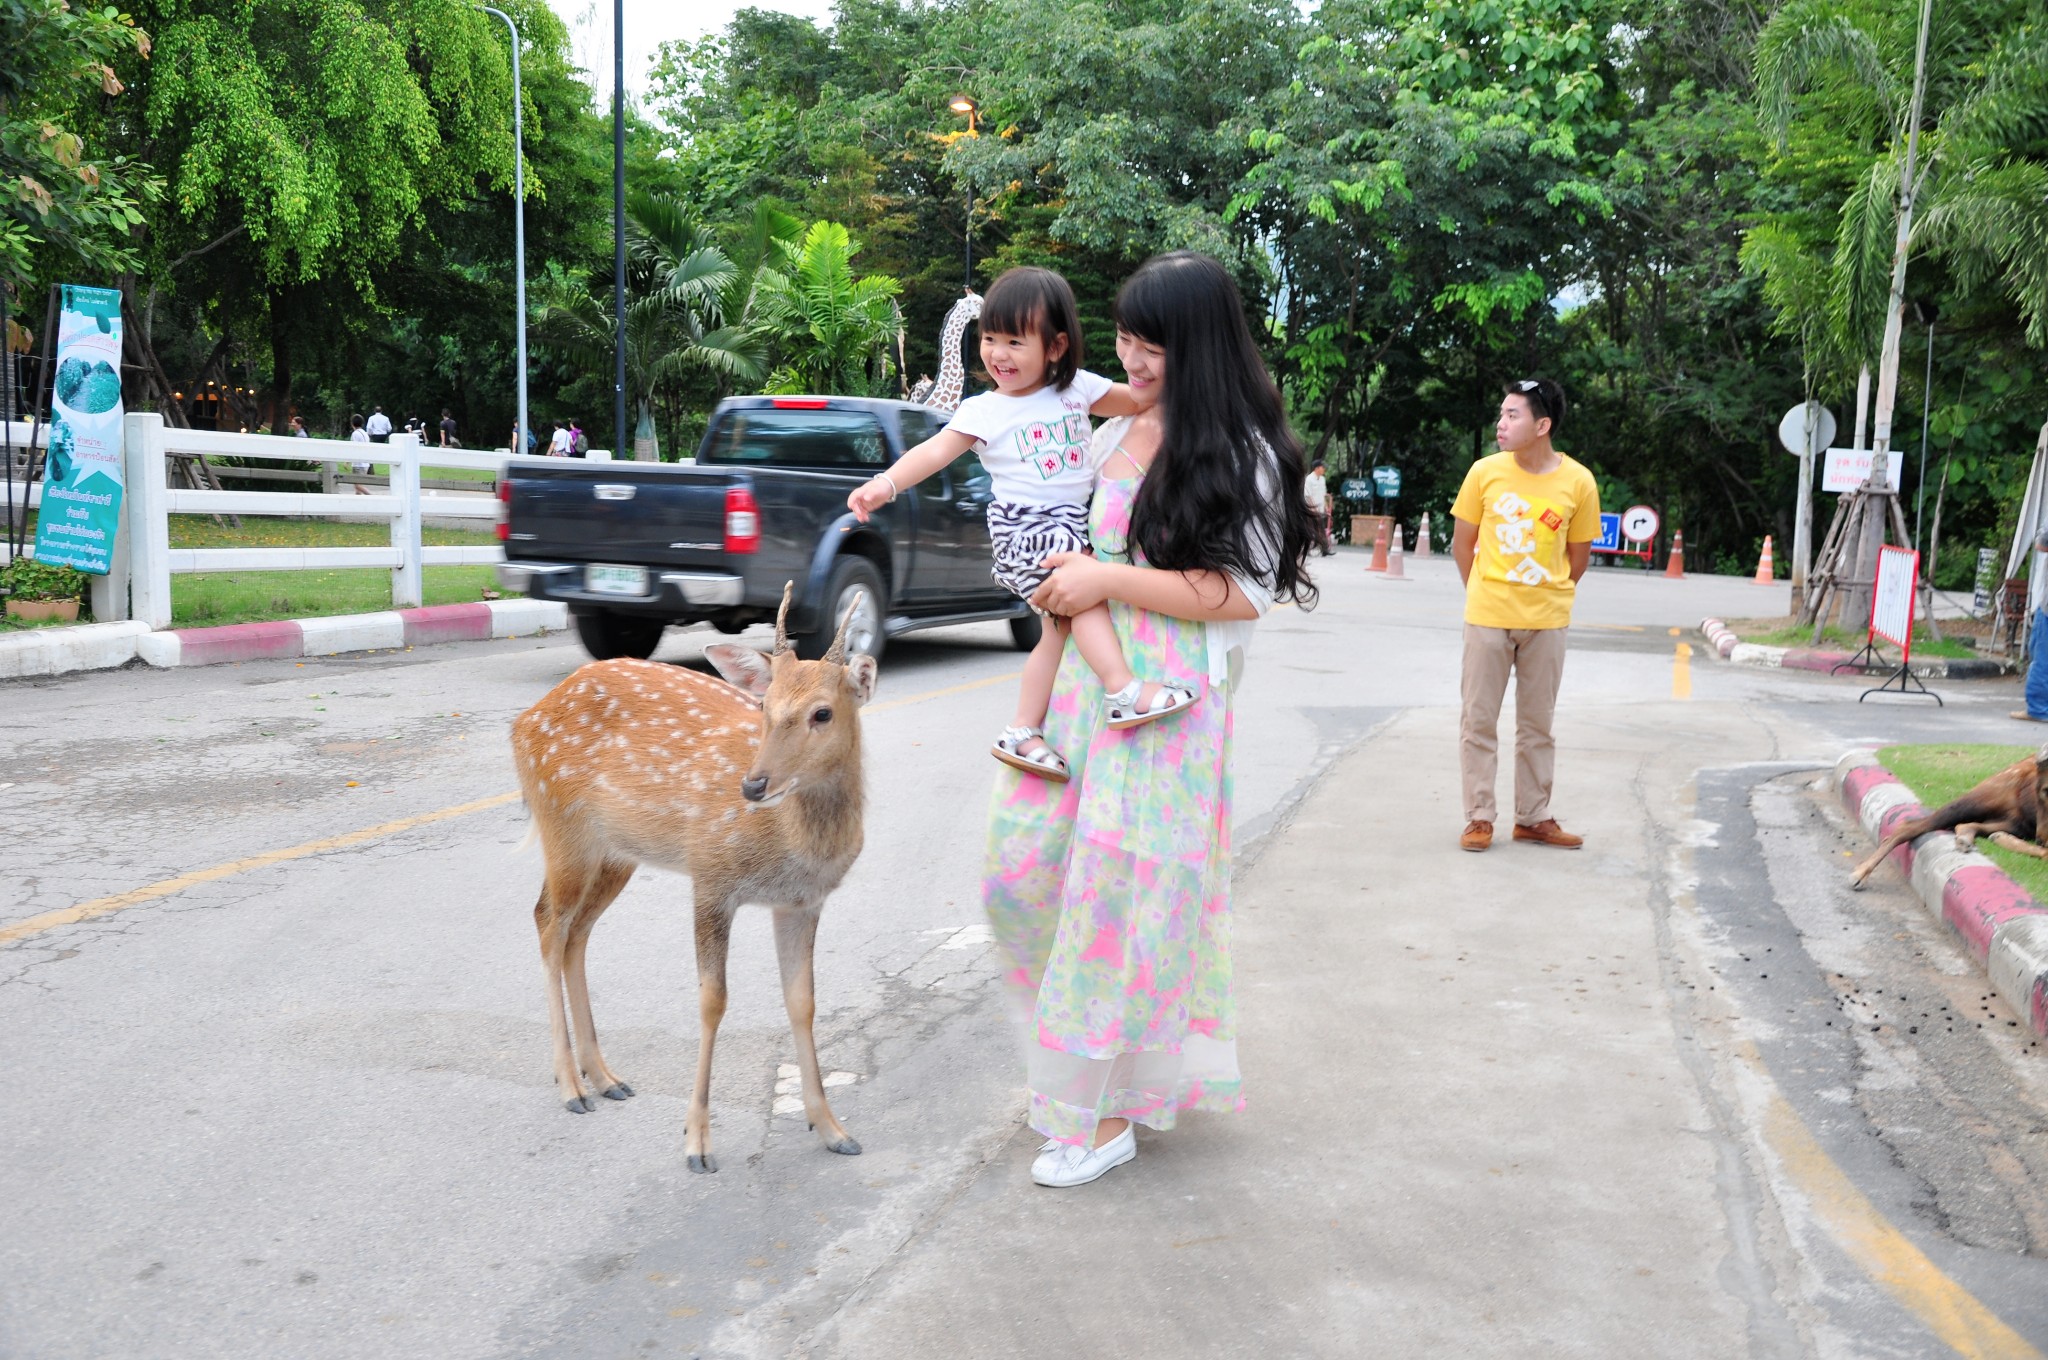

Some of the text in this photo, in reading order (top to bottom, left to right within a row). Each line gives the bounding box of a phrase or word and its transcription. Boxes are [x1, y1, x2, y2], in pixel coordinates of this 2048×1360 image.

[1014, 413, 1084, 460] LOVE
[1034, 444, 1084, 481] DO
[1346, 489, 1370, 498] STOP
